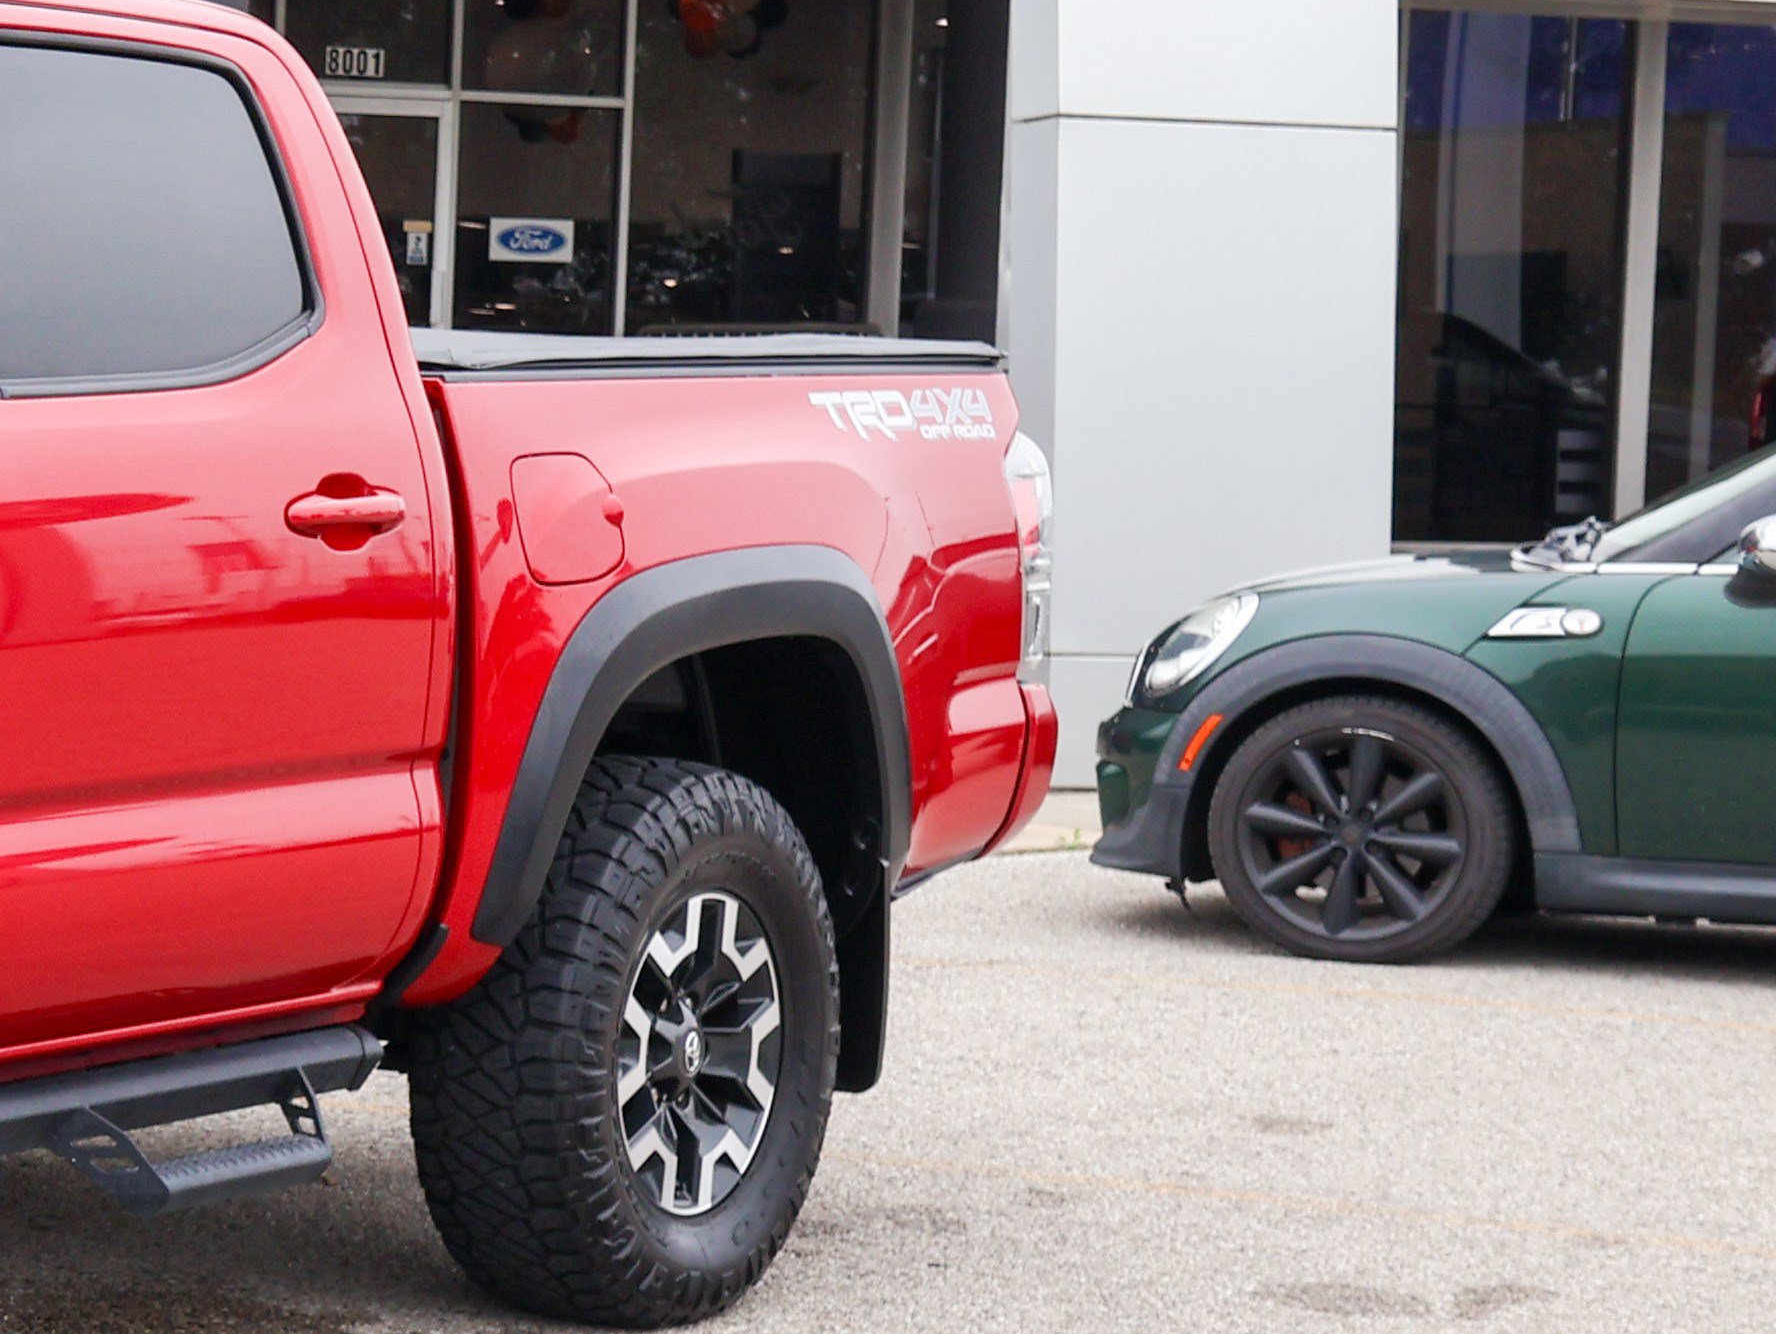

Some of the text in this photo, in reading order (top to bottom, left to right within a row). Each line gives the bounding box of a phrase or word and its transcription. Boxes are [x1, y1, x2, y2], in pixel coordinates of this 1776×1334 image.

[328, 48, 382, 76] 8001
[508, 228, 555, 251] Ford
[808, 389, 917, 443] TRD
[919, 423, 998, 440] OFF ROAD
